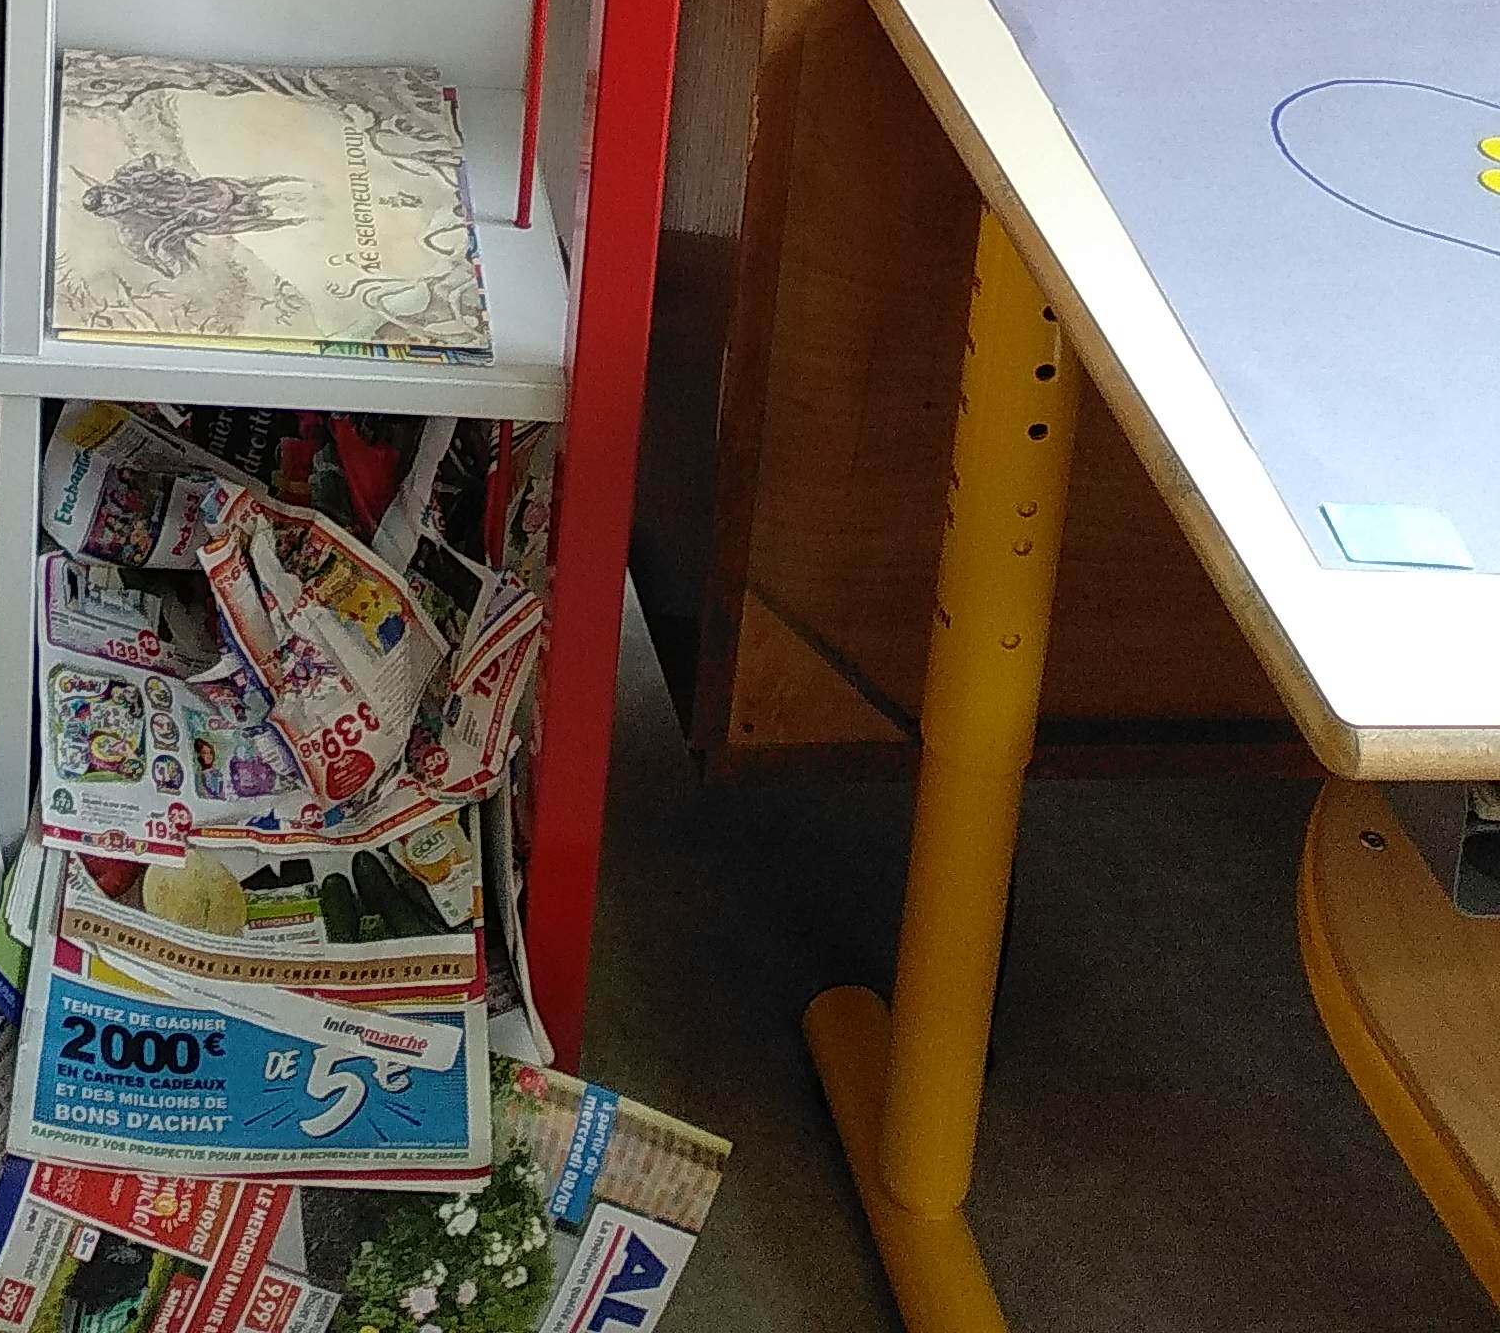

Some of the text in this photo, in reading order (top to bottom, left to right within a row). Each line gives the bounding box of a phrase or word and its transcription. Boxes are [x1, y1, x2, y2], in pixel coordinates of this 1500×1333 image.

[349, 173, 379, 248] SEIGNEUR
[158, 948, 217, 973] CONTRE
[222, 962, 242, 975] LA
[250, 965, 275, 979] VIE
[339, 966, 396, 981] DEPUIS
[430, 962, 462, 976] ANS
[61, 996, 228, 1031] TENTEZ DE GAGNER
[57, 1063, 228, 1091] EN CARTES CADEAUX
[263, 1049, 301, 1081] DE
[55, 1082, 228, 1110] ET DES MILLIONS DE
[54, 1102, 120, 1126] BONS
[30, 1124, 100, 1148] RAPPORTEZ
[102, 1139, 127, 1152] VOS
[128, 1143, 207, 1161] PROSPECTUS
[207, 1150, 241, 1162] POUR
[300, 1150, 371, 1161] RECHERCHE
[372, 1150, 398, 1161] SUR
[569, 1093, 597, 1174] mercredi
[590, 1111, 610, 1156] partir
[583, 1155, 596, 1177] du
[598, 1220, 612, 1234] La
[211, 1187, 275, 1326] LE MERCREDI 8 MAI DE
